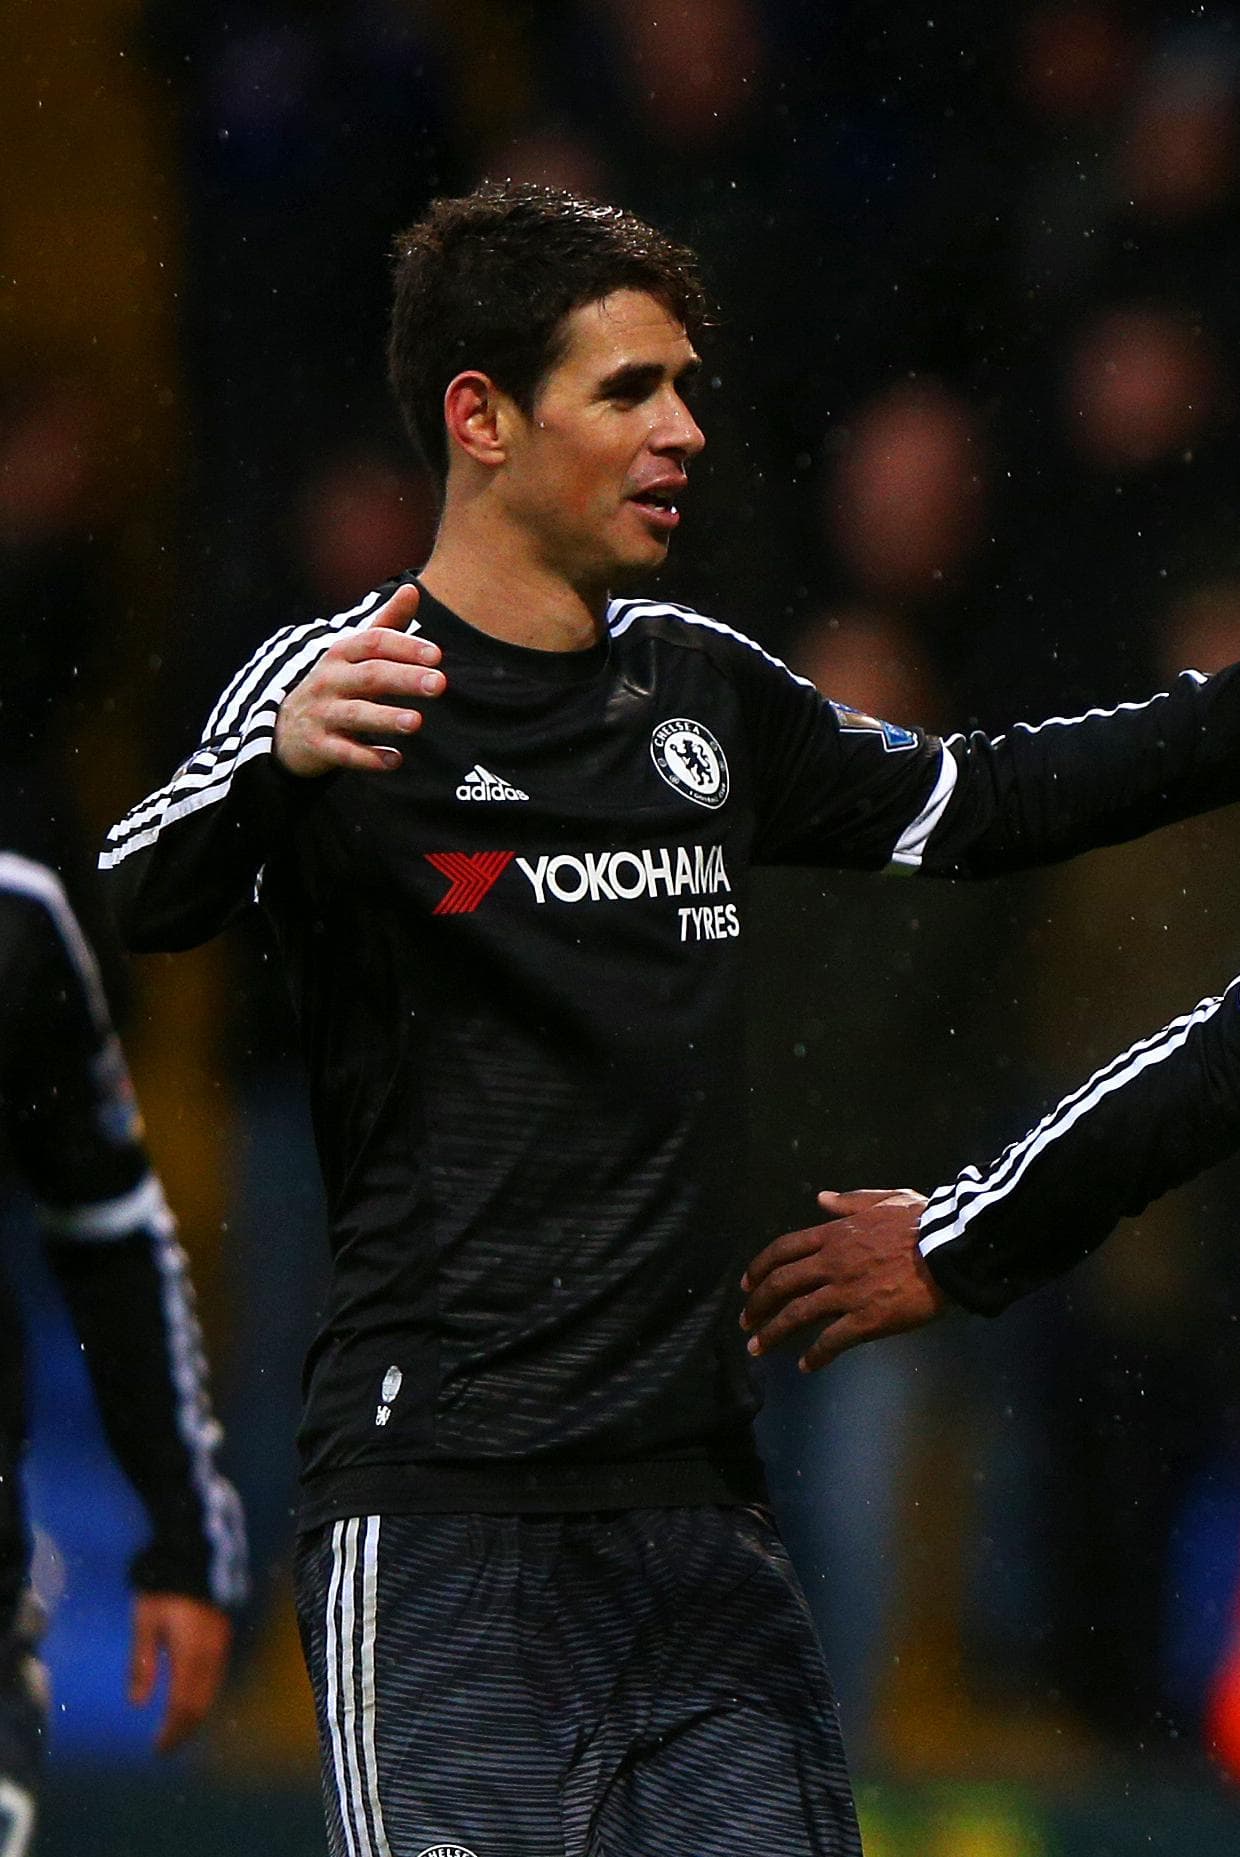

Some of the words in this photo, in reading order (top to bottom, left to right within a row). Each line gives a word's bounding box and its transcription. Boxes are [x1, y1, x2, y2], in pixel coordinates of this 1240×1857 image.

[654, 721, 700, 747] CHELSEA
[455, 781, 530, 801] adidas
[515, 845, 732, 904] YOKOHAMA
[678, 903, 740, 942] TYRES
